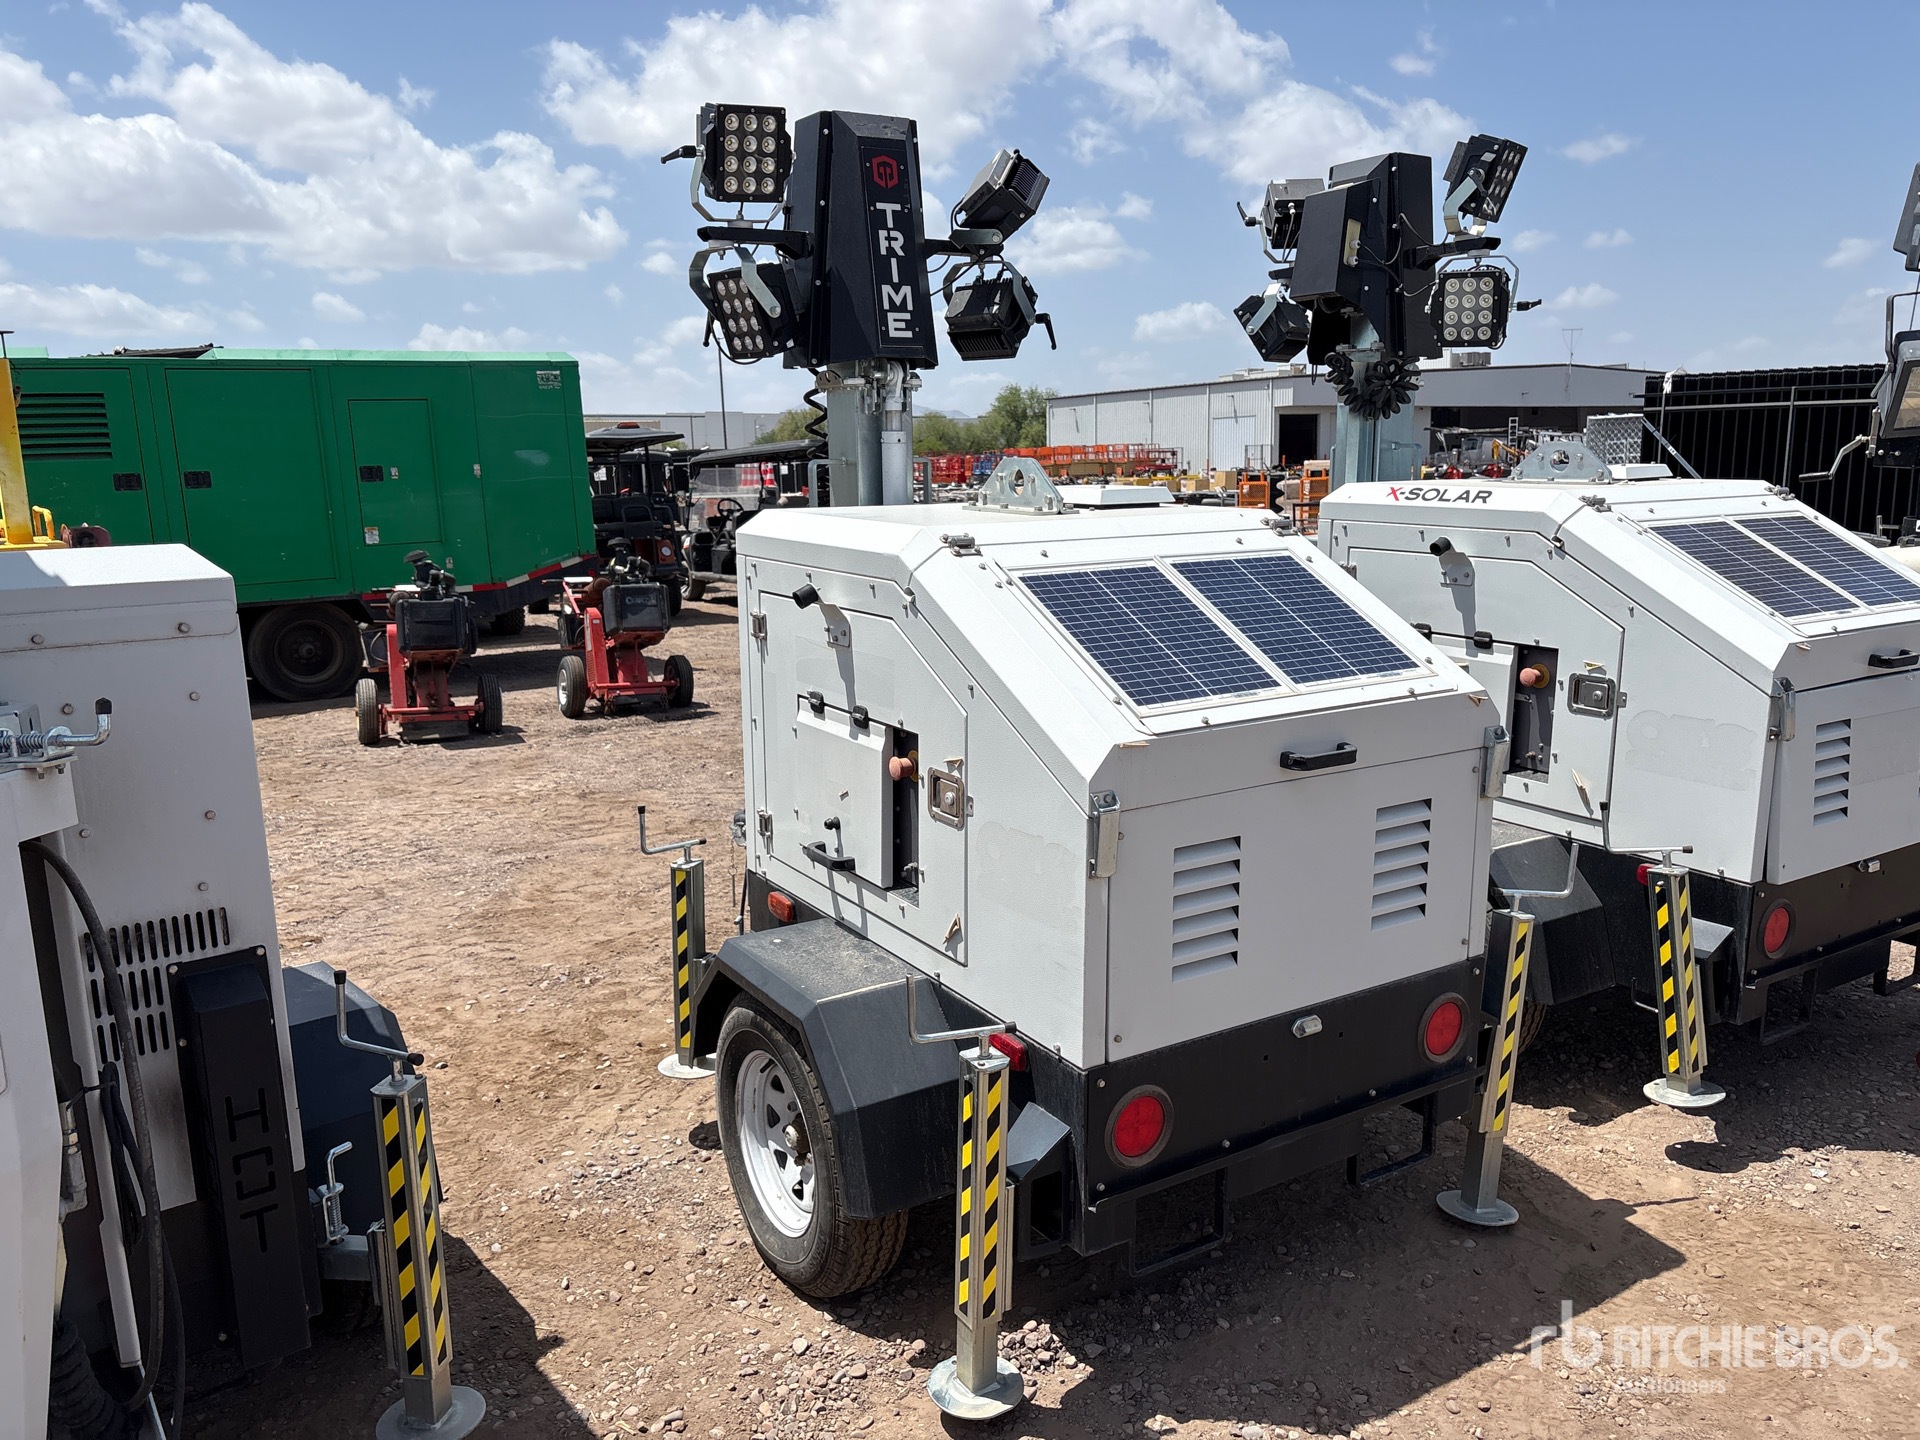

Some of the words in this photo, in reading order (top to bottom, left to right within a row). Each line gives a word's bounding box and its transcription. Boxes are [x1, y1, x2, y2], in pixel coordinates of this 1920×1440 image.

[875, 201, 914, 338] TRIME
[1386, 486, 1493, 504] X-SOLAR
[225, 1088, 279, 1252] HOT
